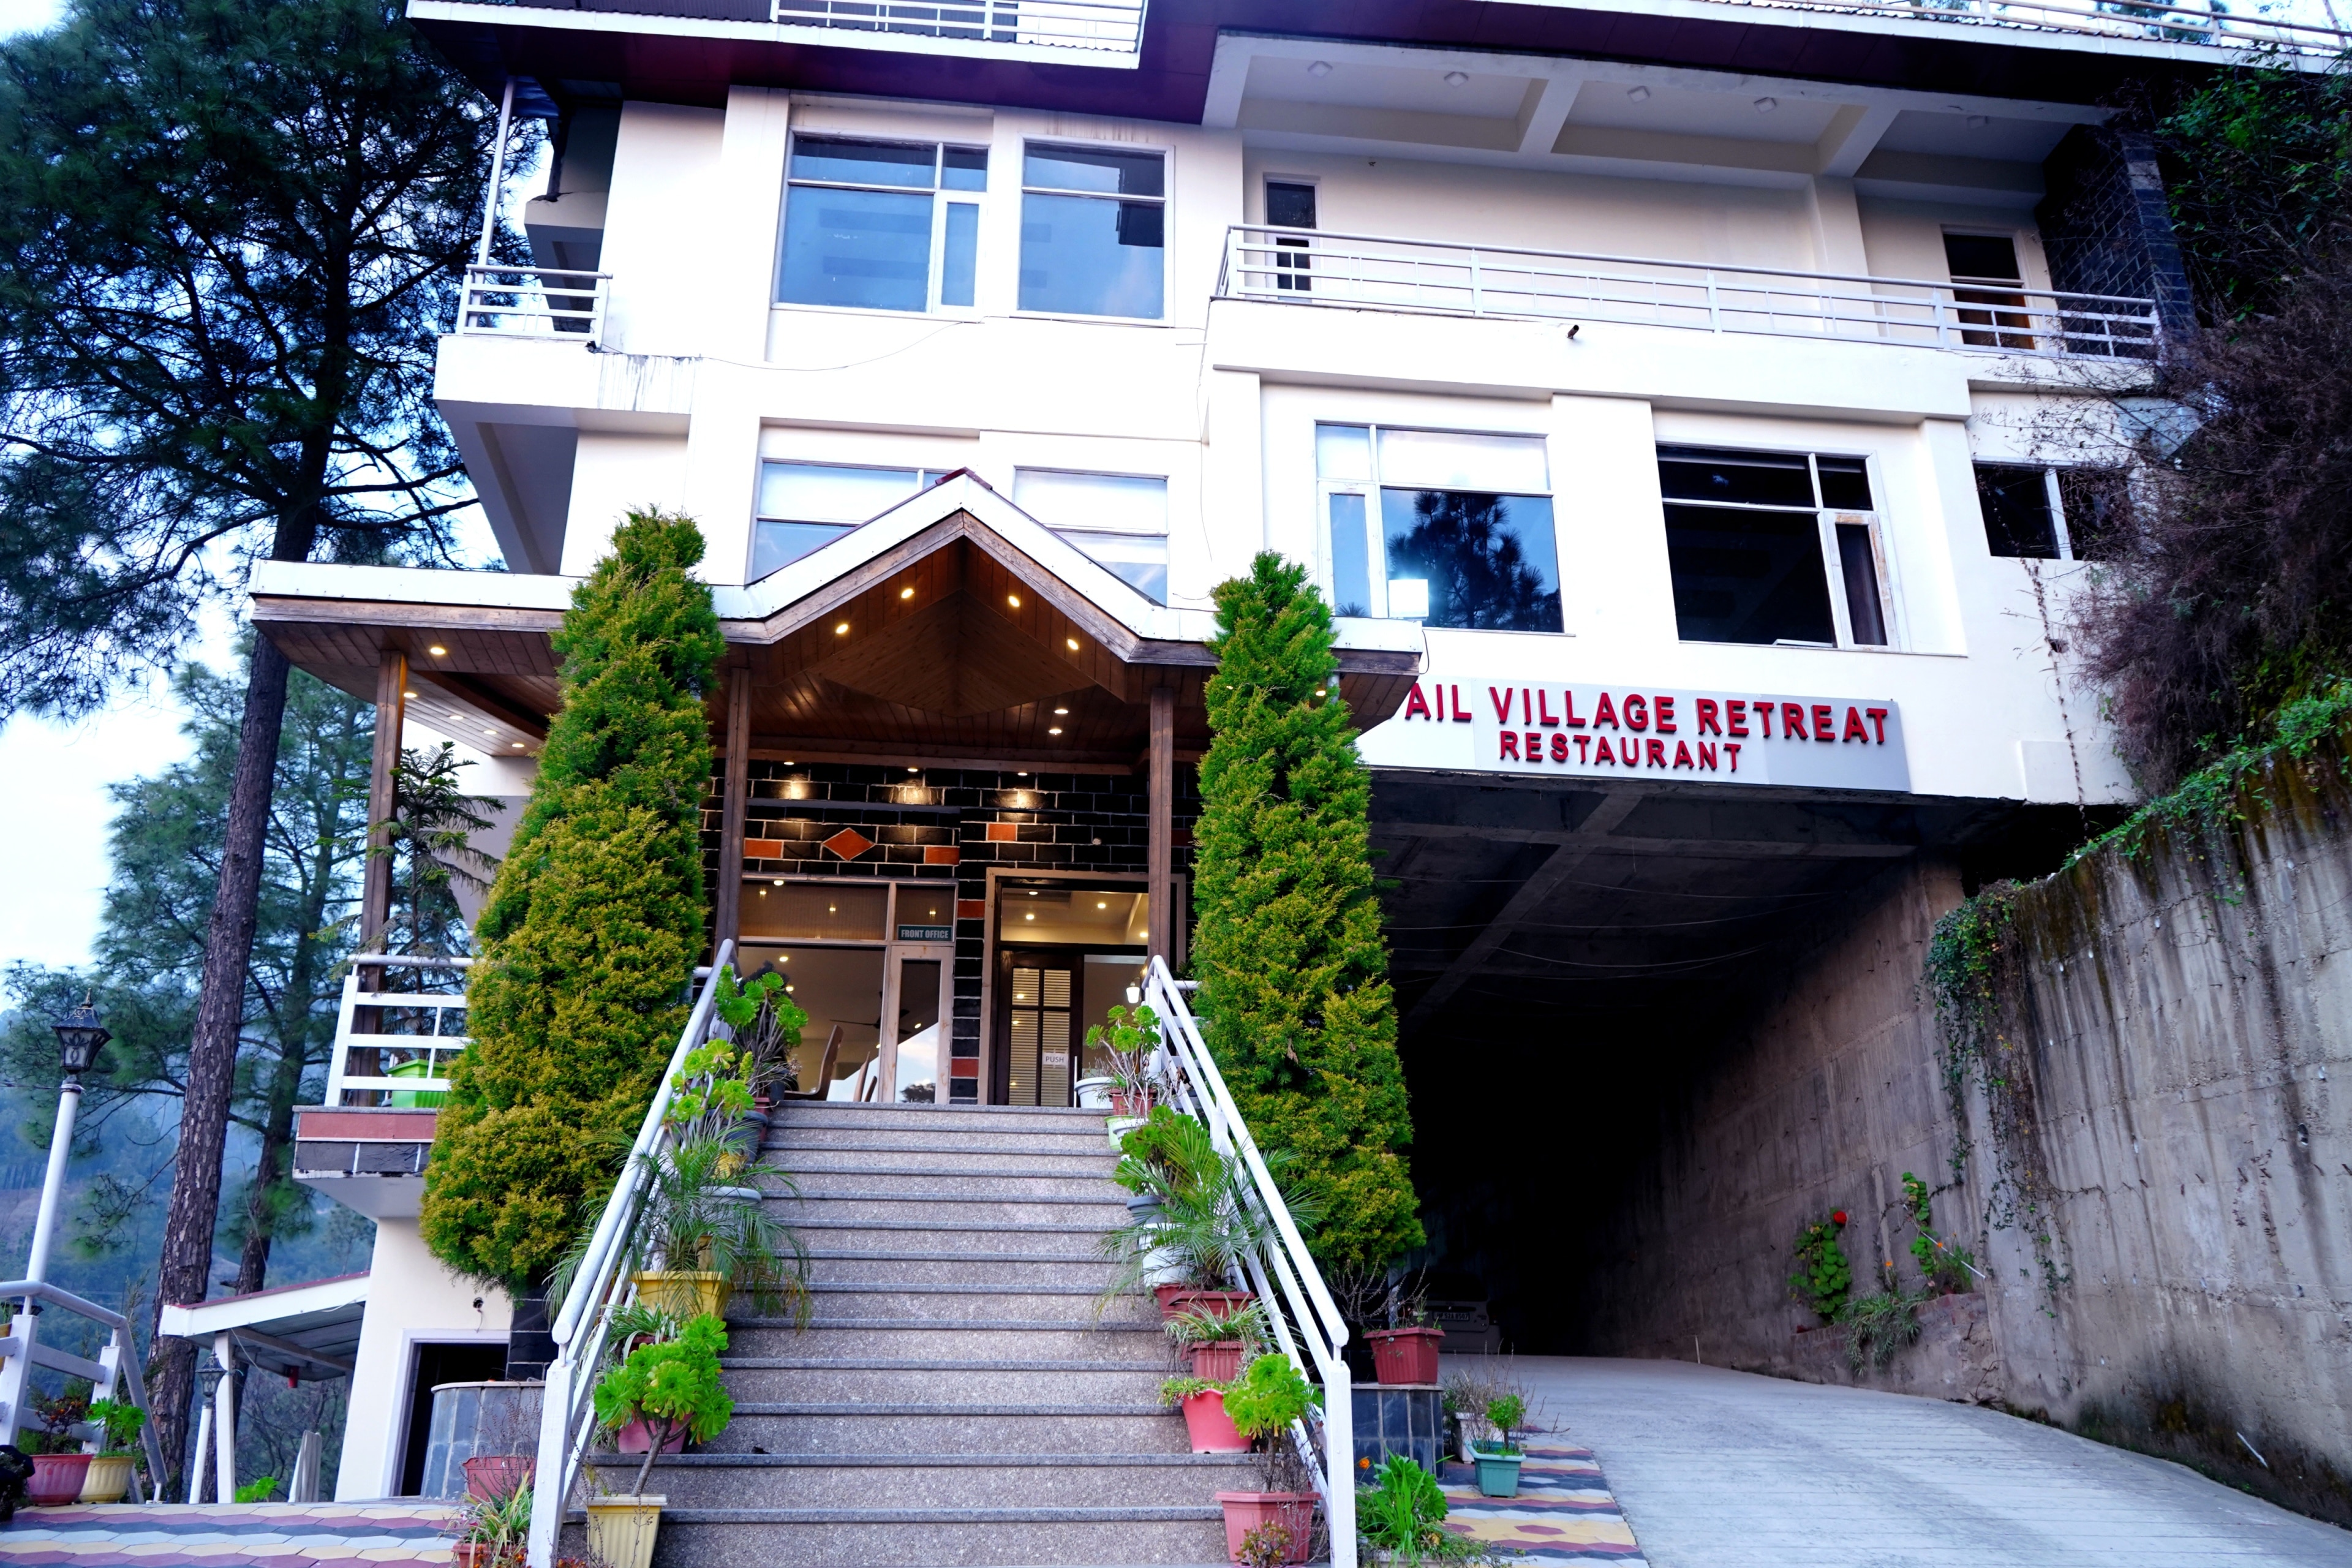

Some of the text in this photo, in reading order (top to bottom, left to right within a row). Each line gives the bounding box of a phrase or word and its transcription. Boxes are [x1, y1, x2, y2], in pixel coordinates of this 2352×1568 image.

[1405, 683, 1888, 745] AIL VILLAGE RETREAT
[1499, 731, 1741, 772] RESTAURANT
[901, 929, 949, 938] FRONT OFFICE
